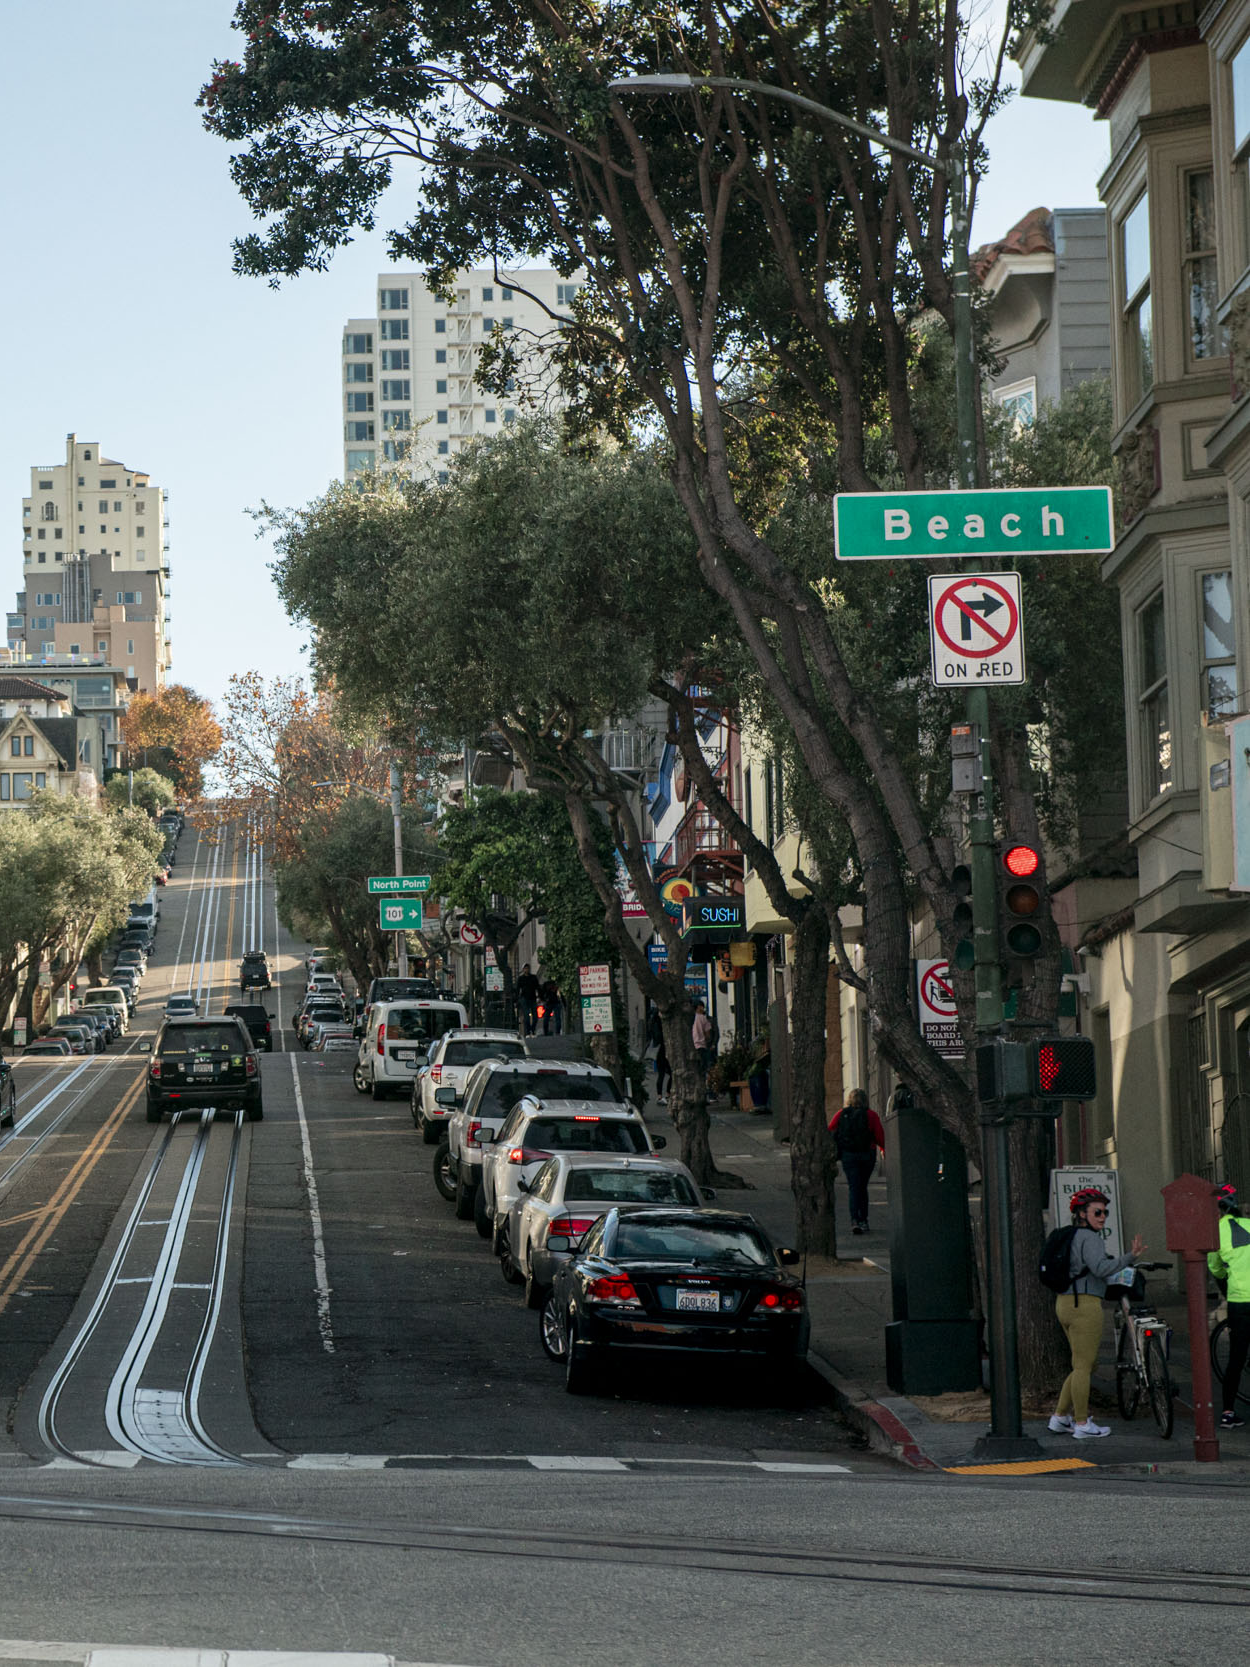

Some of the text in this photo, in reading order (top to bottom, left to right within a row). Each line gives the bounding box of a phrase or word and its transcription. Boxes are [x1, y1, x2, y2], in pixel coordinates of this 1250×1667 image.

[883, 504, 1065, 541] Beach
[944, 662, 1013, 678] ON RED
[373, 880, 426, 889] North Point
[387, 910, 402, 919] 101
[701, 907, 739, 922] SUSHI
[1078, 1175, 1094, 1183] the
